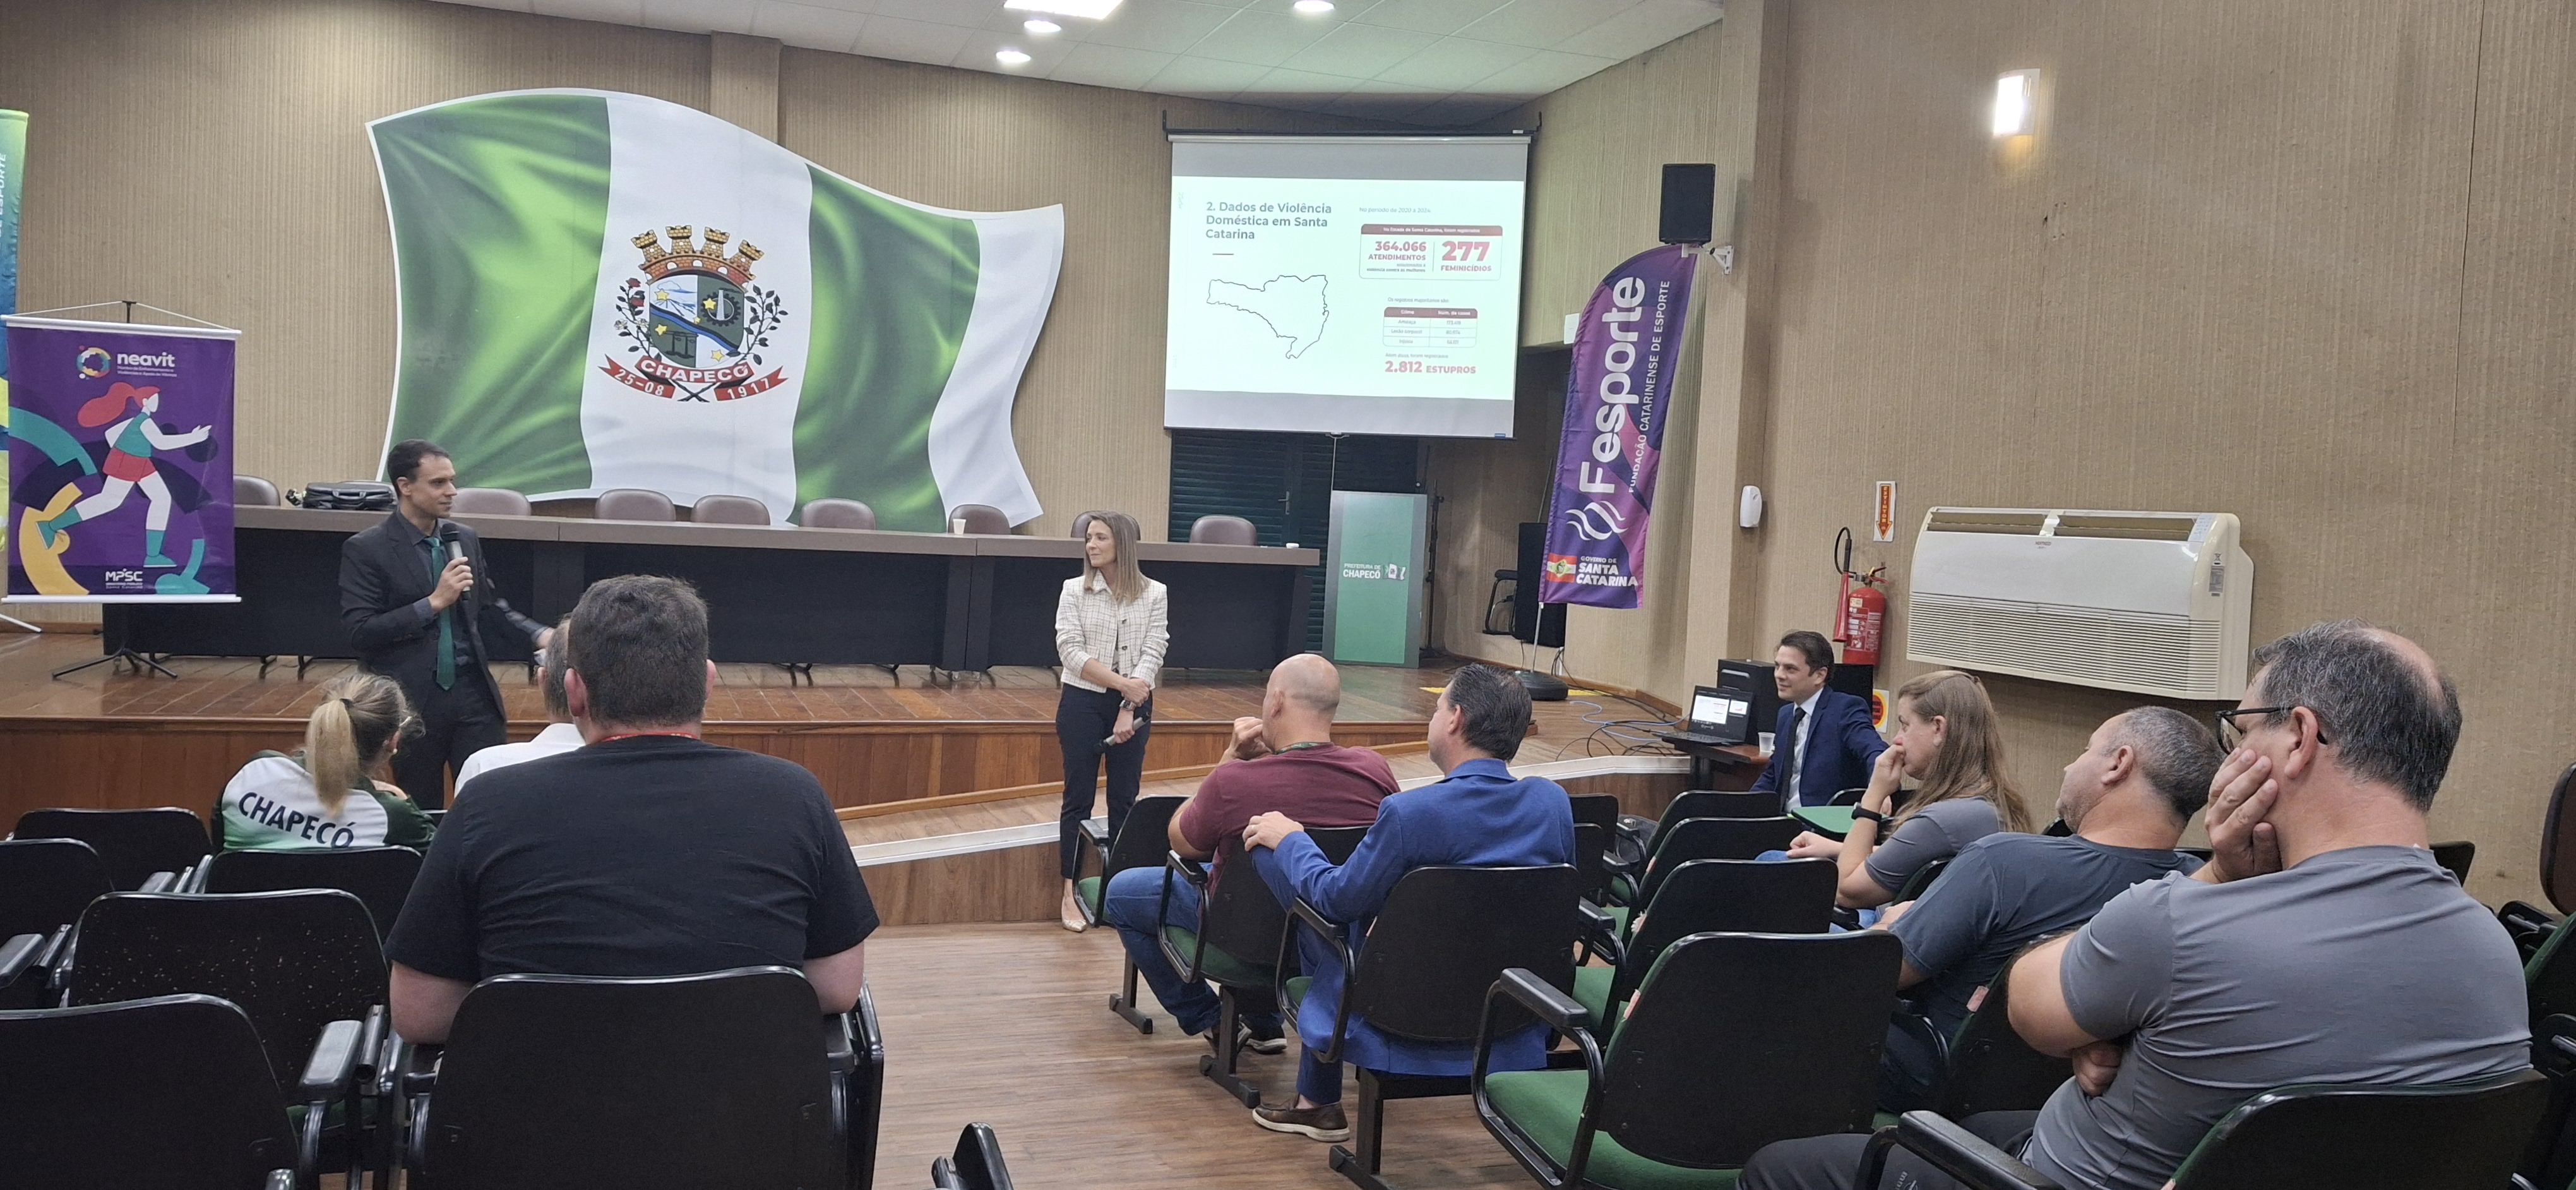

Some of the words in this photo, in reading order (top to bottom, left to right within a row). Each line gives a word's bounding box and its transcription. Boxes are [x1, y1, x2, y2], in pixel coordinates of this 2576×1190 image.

[1206, 201, 1215, 212] 2.
[1219, 201, 1256, 212] Dados
[1259, 203, 1274, 212] de
[1277, 202, 1332, 213] Violência
[1206, 215, 1268, 225] Doméstica
[1294, 217, 1327, 227] Santa
[1205, 229, 1255, 239] Catarina
[1375, 241, 1426, 252] 364.066
[1441, 241, 1490, 261] 277
[1654, 280, 1670, 332] ESPORTE
[1650, 336, 1662, 351] DE
[117, 352, 176, 368] neavit
[1385, 360, 1422, 373] 2.812
[1426, 365, 1476, 374] ESTUPROS
[614, 368, 665, 397] 25-08
[727, 378, 771, 400] 1917
[1579, 277, 1645, 493] Fesporte
[1639, 354, 1659, 431] CATARINENSE
[1628, 435, 1647, 493] FUNDAÇÃO
[105, 570, 143, 582] MPSC
[1343, 569, 1381, 579] CHAPECÓ
[1578, 563, 1619, 575] SANTA
[1576, 574, 1638, 587] CATARINA
[238, 792, 357, 849] CHAPECÓ
